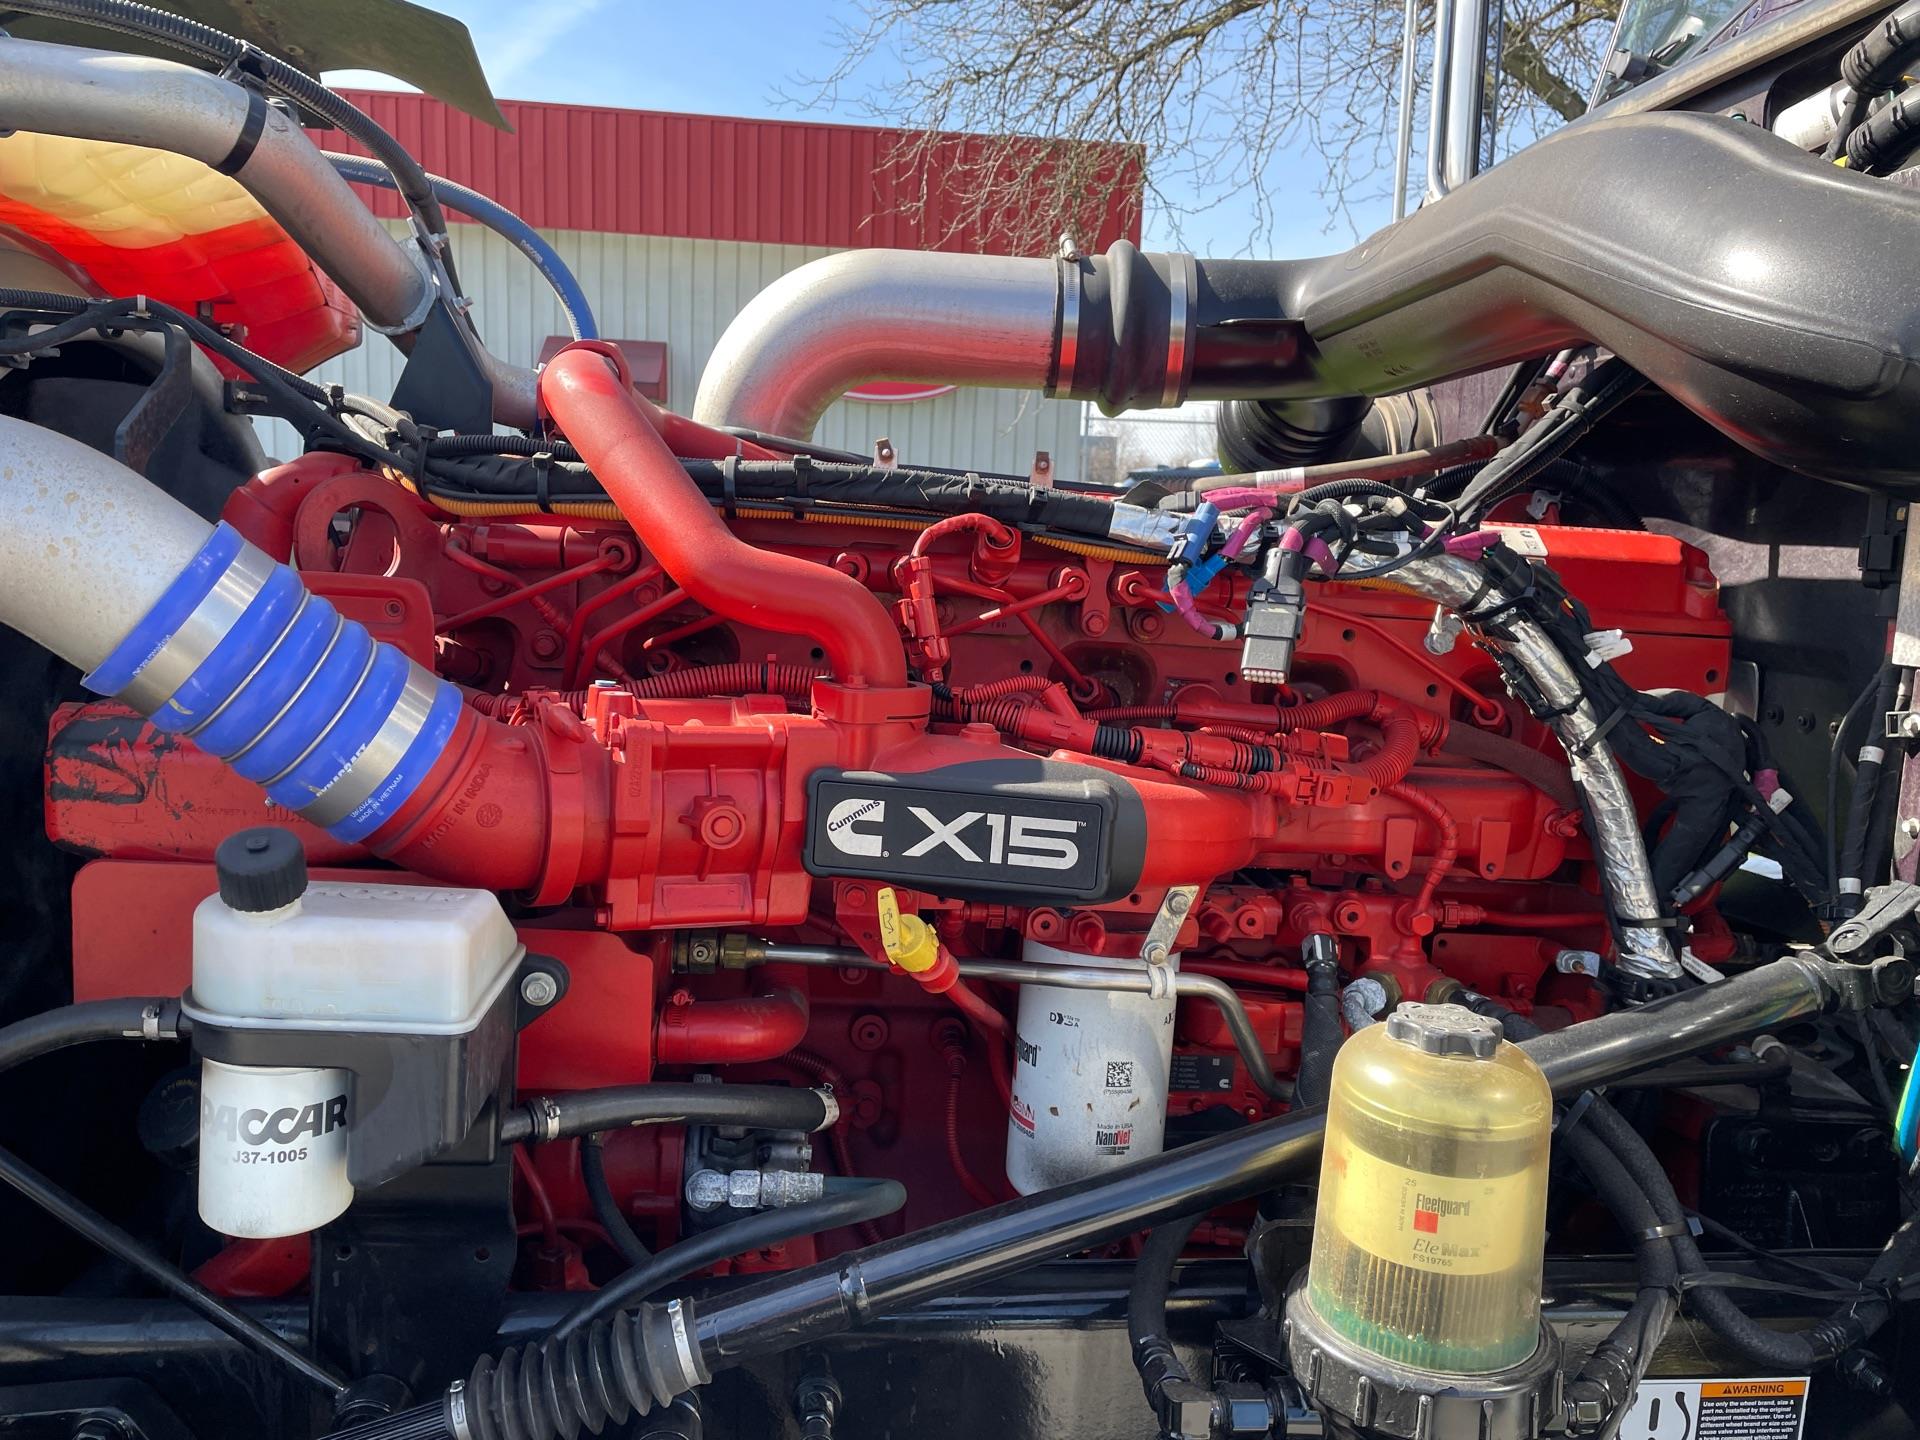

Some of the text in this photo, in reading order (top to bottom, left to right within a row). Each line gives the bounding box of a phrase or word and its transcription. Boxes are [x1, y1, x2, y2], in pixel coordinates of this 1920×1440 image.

[378, 774, 404, 802] VIETNAM
[421, 763, 493, 849] MADE IN INDIA
[828, 800, 880, 832] Cummins
[901, 806, 1079, 870] X15
[202, 1093, 348, 1146] PACCAR
[233, 1147, 308, 1165] J37-1005
[1416, 1193, 1470, 1217] Fleetguard
[1412, 1253, 1453, 1267] FS19765
[1733, 1385, 1784, 1393] WARNING
